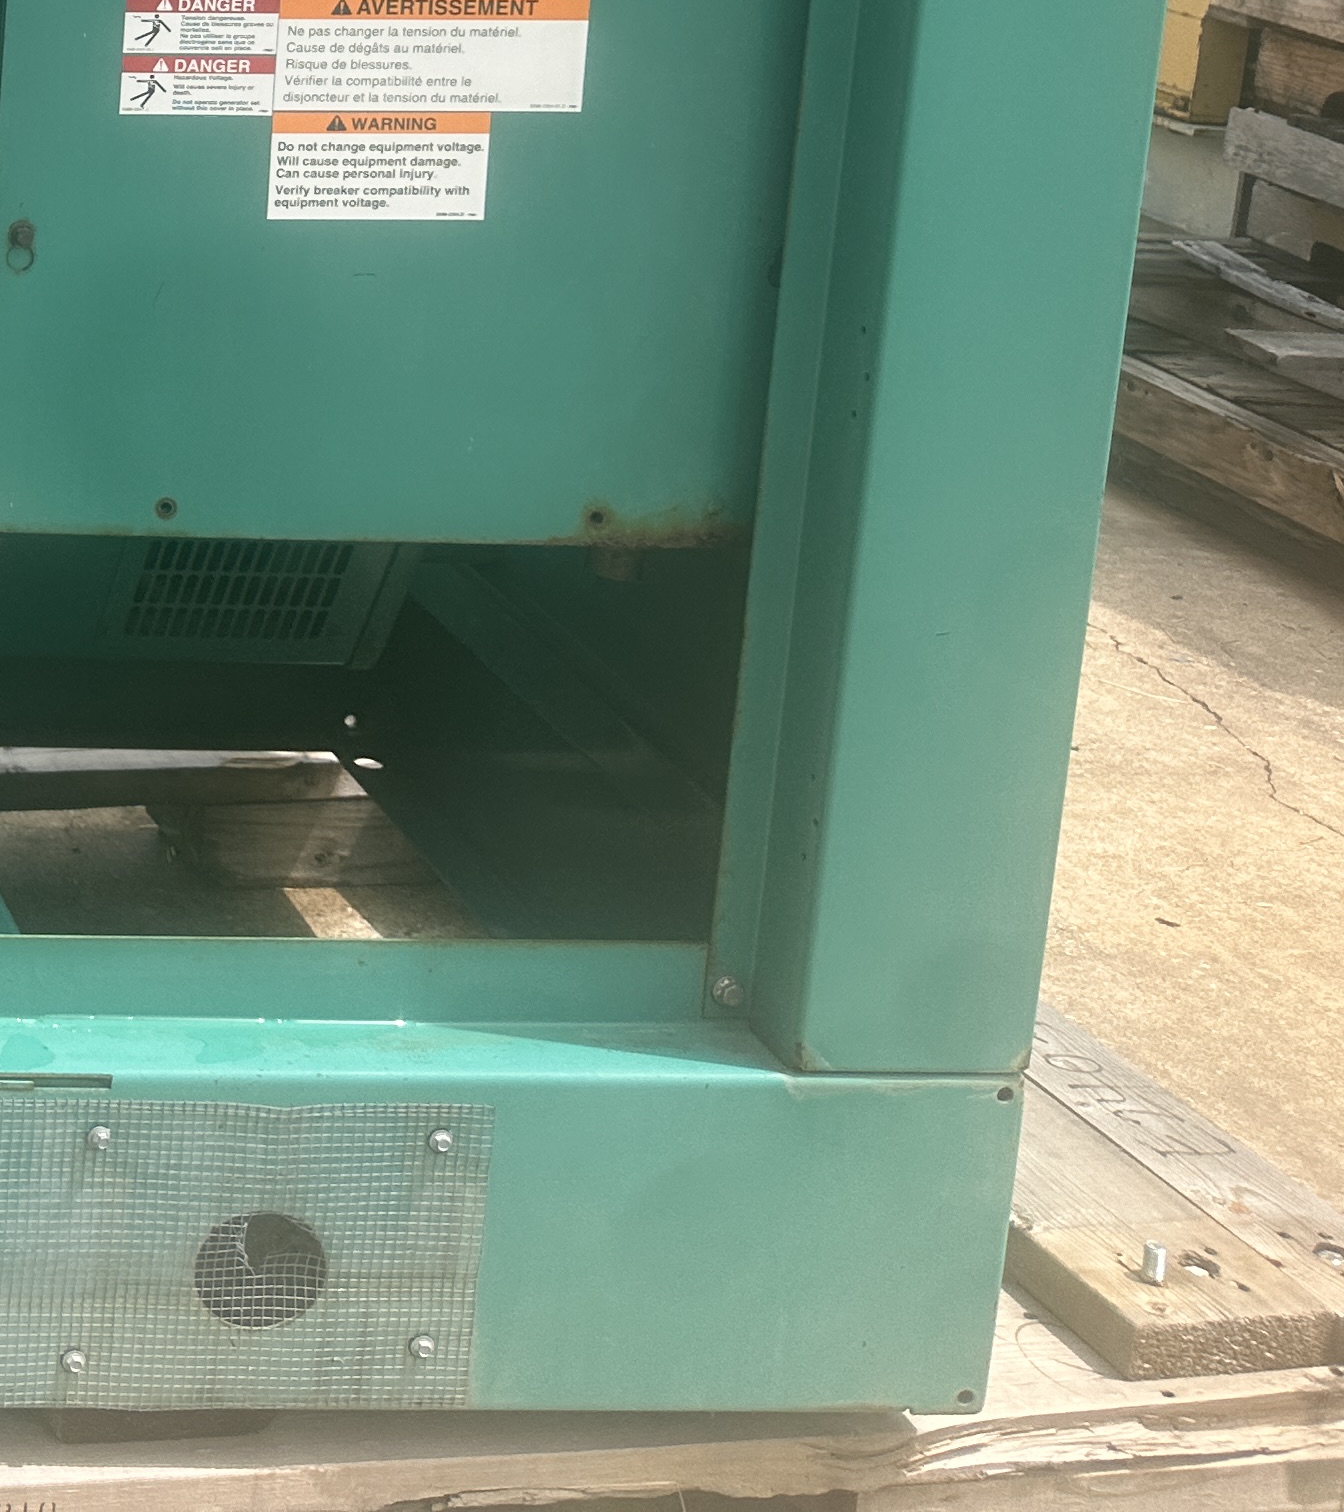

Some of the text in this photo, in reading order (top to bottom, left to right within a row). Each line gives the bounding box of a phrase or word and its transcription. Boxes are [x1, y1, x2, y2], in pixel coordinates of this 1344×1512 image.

[356, 0, 539, 16] AVERTISSEMENT
[287, 26, 305, 37] Ne
[308, 28, 331, 39] pas
[334, 26, 385, 39] changer
[388, 27, 399, 37] la
[403, 27, 447, 38] tension
[450, 27, 466, 38] du
[286, 42, 326, 54] Cause
[329, 42, 345, 54] de
[348, 42, 390, 55] dégâts
[394, 45, 408, 54] au
[174, 59, 251, 73] DANGER
[286, 59, 412, 72] Risque de blessures.
[285, 75, 472, 89] Vérifier la compatibilité entre le
[283, 92, 349, 106] disjoncteur
[353, 93, 365, 103] et
[368, 92, 379, 103] la
[383, 92, 427, 103] tension
[431, 92, 446, 103] du
[352, 117, 437, 131] WARNING
[278, 142, 485, 154] Do not change equipment voltage.
[277, 157, 461, 169] Will cause equipment damage.
[276, 169, 300, 179] Can
[303, 171, 339, 179] cause
[343, 170, 396, 181] personal
[276, 186, 470, 198] Verify breaker compatibility with
[274, 198, 390, 210] equipment voltage.
